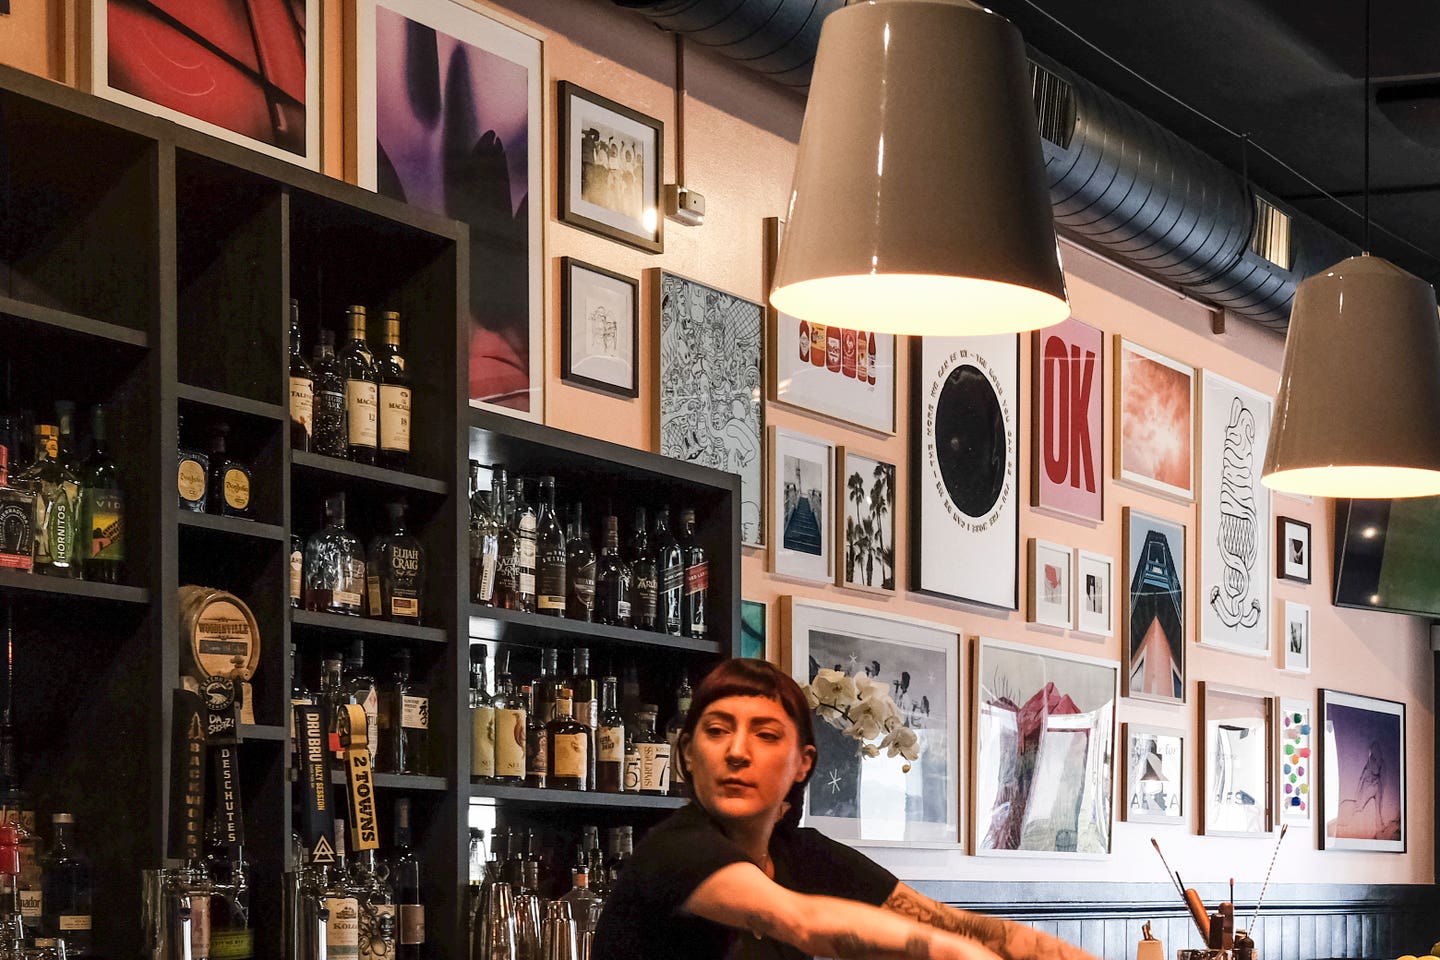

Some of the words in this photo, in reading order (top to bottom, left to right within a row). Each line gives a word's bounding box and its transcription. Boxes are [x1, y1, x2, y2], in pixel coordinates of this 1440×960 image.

[1044, 336, 1096, 493] OK
[57, 505, 66, 560] HORNITOS
[393, 546, 419, 560] ELIJAH
[392, 559, 418, 571] CRAIG
[354, 756, 367, 767] 2
[222, 749, 236, 842] DESCHUTES
[316, 782, 325, 811] SESSION
[356, 771, 375, 842] TOWNS
